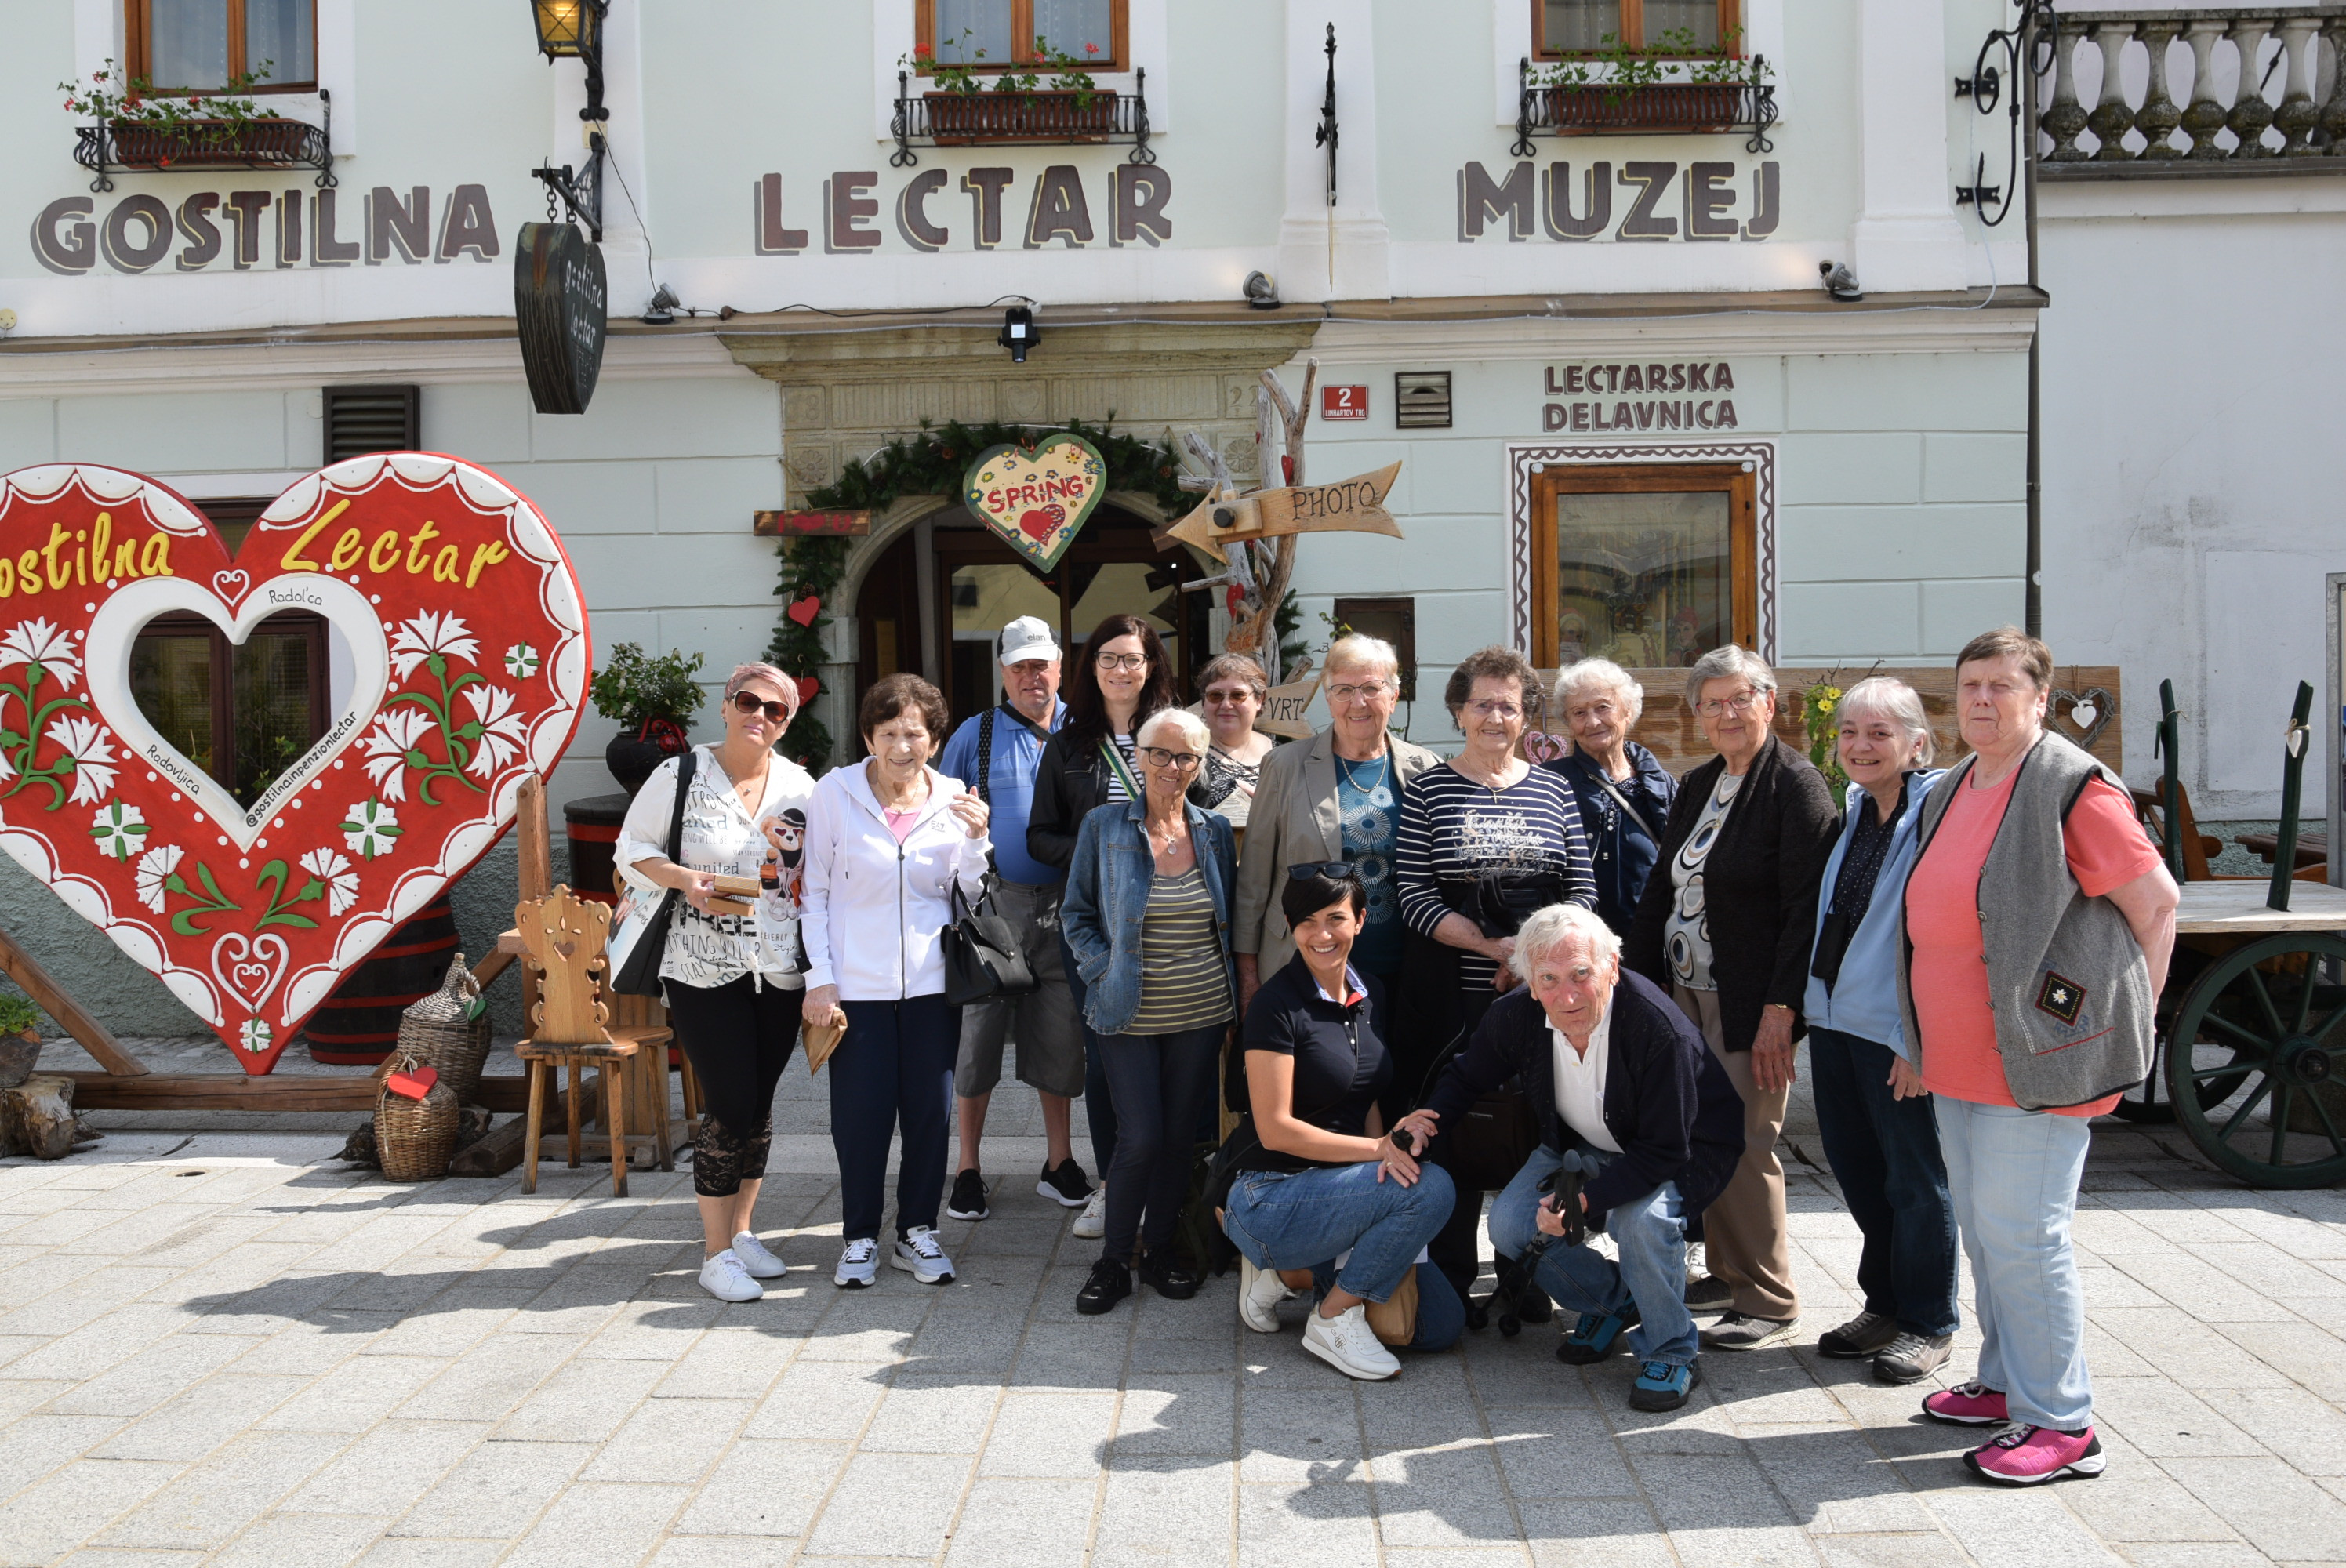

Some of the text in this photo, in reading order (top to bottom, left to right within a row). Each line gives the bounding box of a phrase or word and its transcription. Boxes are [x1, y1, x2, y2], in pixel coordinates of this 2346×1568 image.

[754, 163, 1172, 256] LECTAR
[1457, 161, 1780, 243] MUZEJ
[30, 183, 500, 275] GOSTILNA
[565, 260, 602, 310] gostilna
[571, 303, 596, 349] lectar
[1338, 387, 1352, 407] 2
[1544, 362, 1734, 395] LECTARSKA
[1543, 399, 1738, 432] DELAVNICA
[987, 474, 1084, 514] SPRING
[1291, 481, 1375, 521] PHOTO
[281, 499, 510, 589] Lectar
[777, 514, 852, 534] I U
[1268, 696, 1305, 721] VRT
[146, 744, 200, 795] Radovljica
[245, 711, 358, 828] @gostilnainpenzionlectar
[693, 862, 740, 875] united
[774, 942, 799, 955] Style
